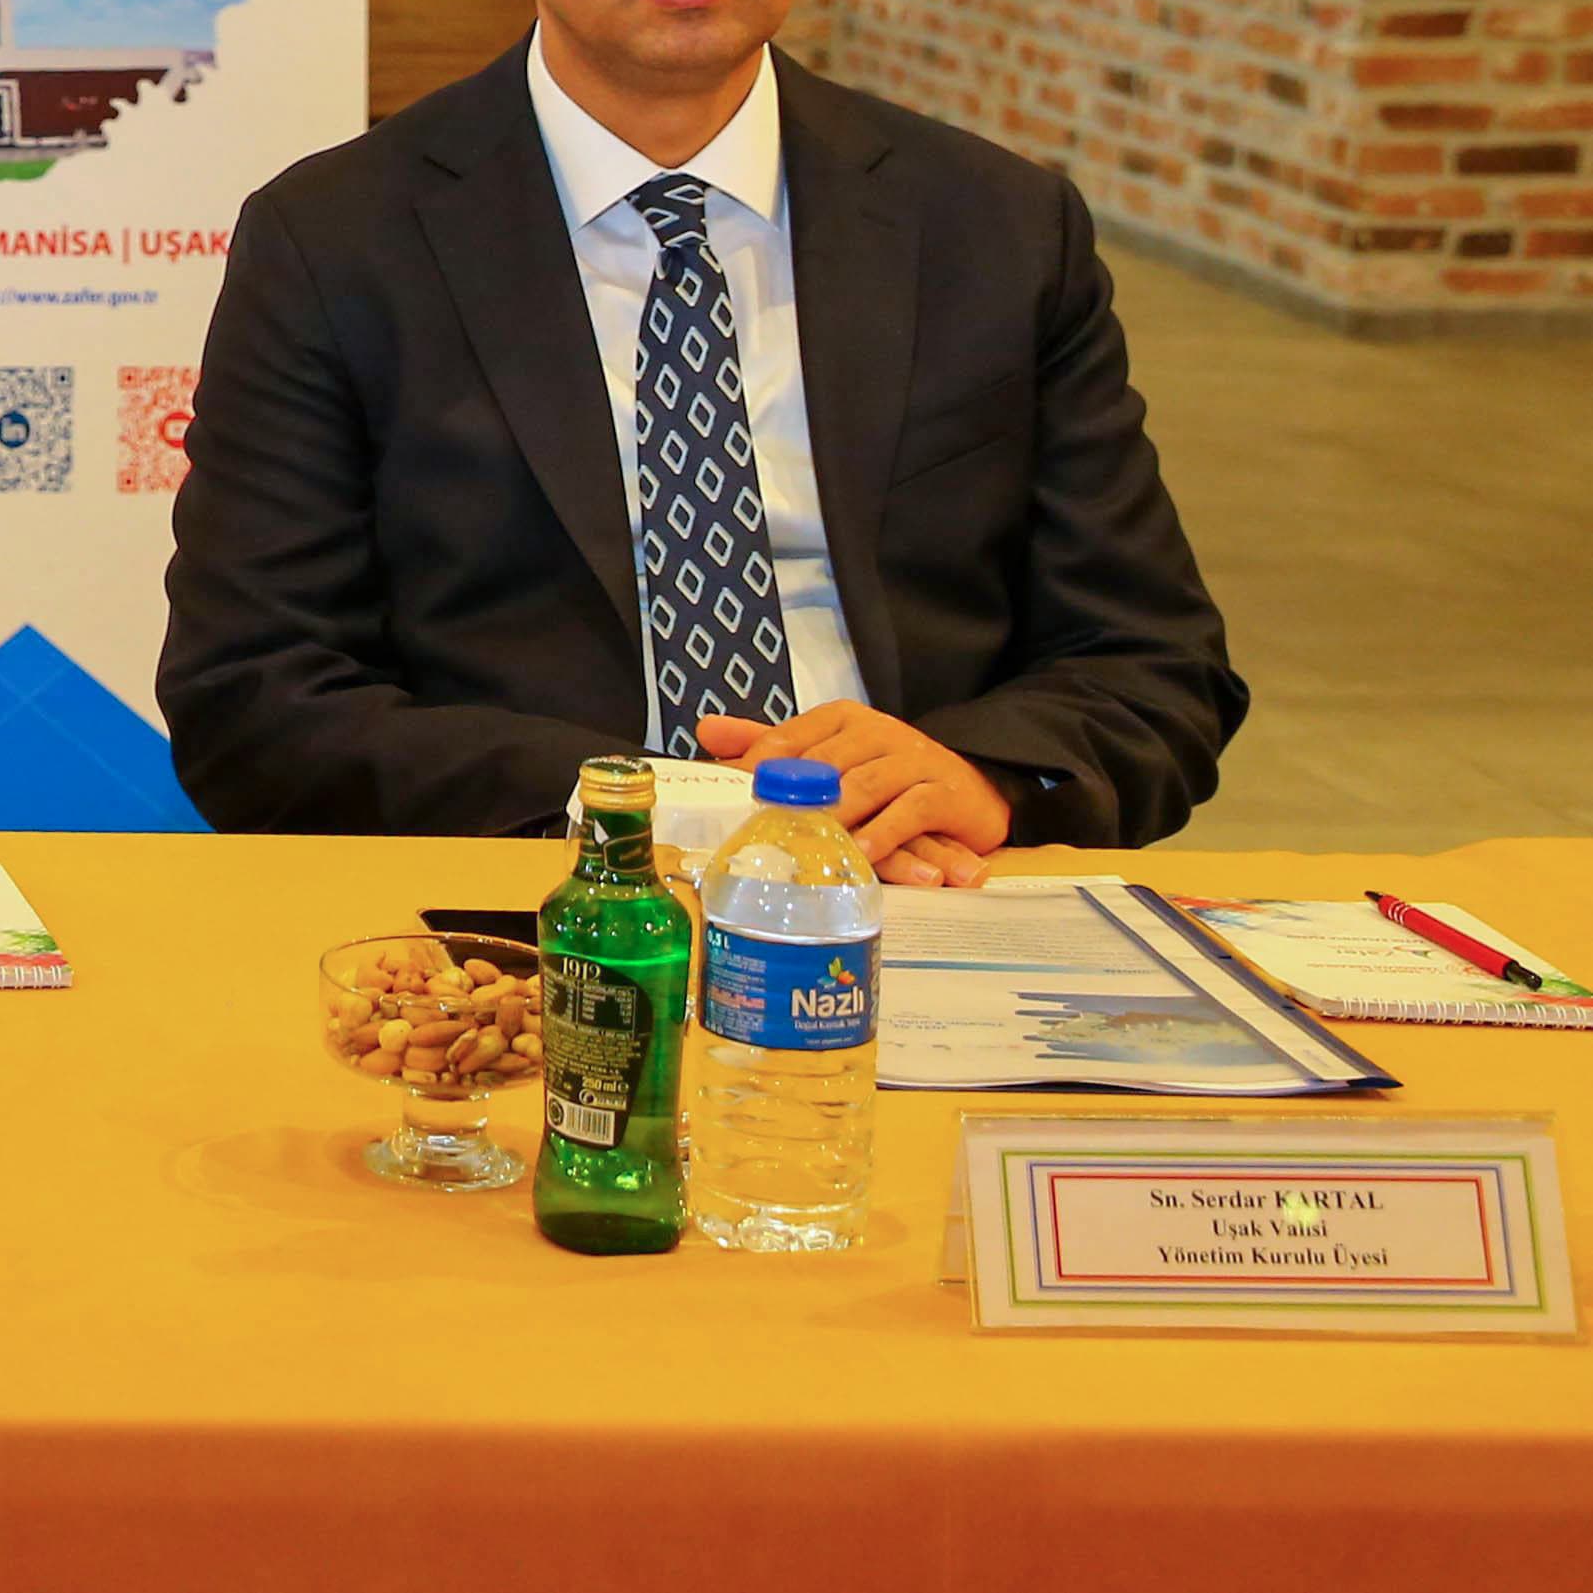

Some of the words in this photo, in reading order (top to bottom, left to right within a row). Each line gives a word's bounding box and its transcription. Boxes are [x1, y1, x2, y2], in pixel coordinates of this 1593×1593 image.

[141, 230, 229, 263] UŞAK
[562, 957, 602, 983] 1912
[791, 985, 864, 1019] Nazlı
[1150, 1189, 1185, 1209] Sn.
[1191, 1189, 1267, 1209] Serdar
[1274, 1190, 1384, 1210] KARTAL
[1212, 1219, 1264, 1240] Uşak
[1270, 1219, 1328, 1238] Valisi
[1157, 1245, 1244, 1265] Yönetim
[1251, 1247, 1326, 1266] Kurulu
[1333, 1242, 1389, 1270] Üyesi
